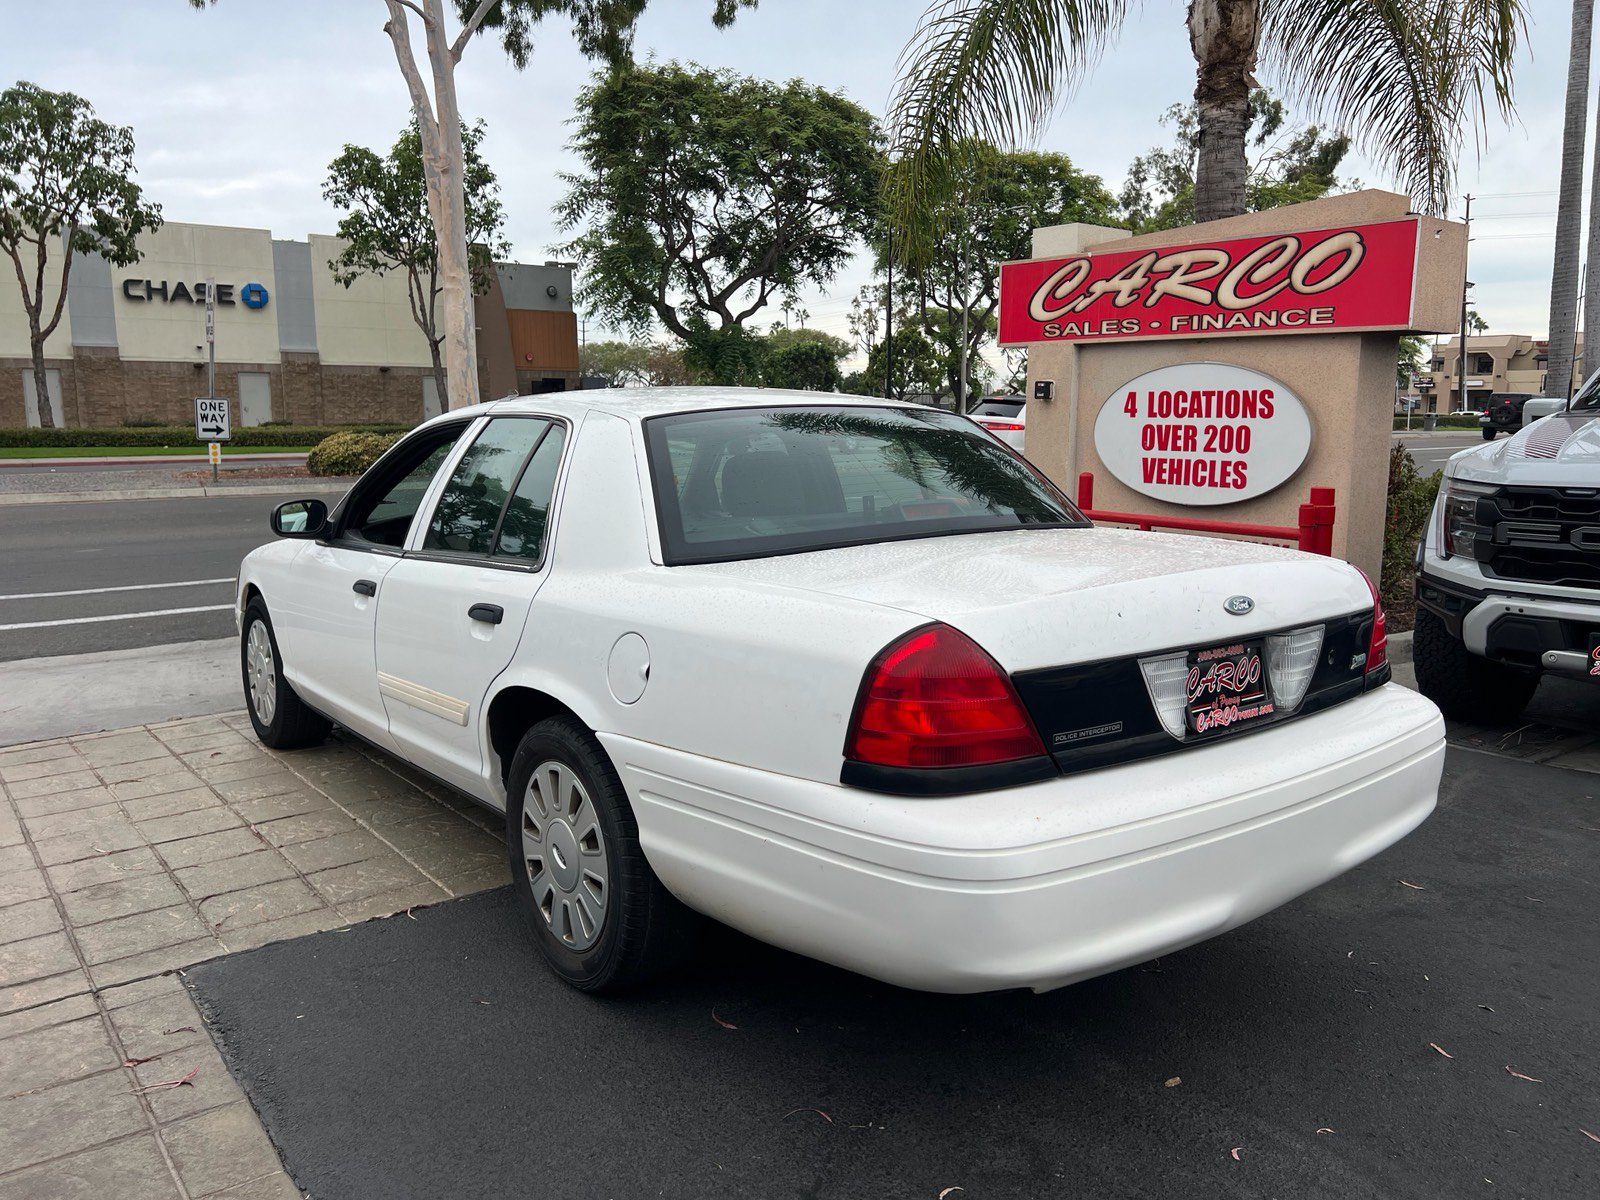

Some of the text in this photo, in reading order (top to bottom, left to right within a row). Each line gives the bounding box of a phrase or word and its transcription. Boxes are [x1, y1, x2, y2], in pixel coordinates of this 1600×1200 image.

[1027, 230, 1366, 322] CARCO
[122, 278, 236, 306] CHASE
[1043, 306, 1336, 338] SALES FINANCE
[200, 401, 225, 412] ONE
[200, 413, 226, 423] WAY
[1123, 389, 1275, 419] 4 LOCATIONS
[1141, 424, 1252, 454] OVER 200
[1141, 457, 1248, 490] VEHICLES
[1185, 655, 1261, 703] CARCO
[1055, 724, 1121, 742] POLICE INTERCEPTOR
